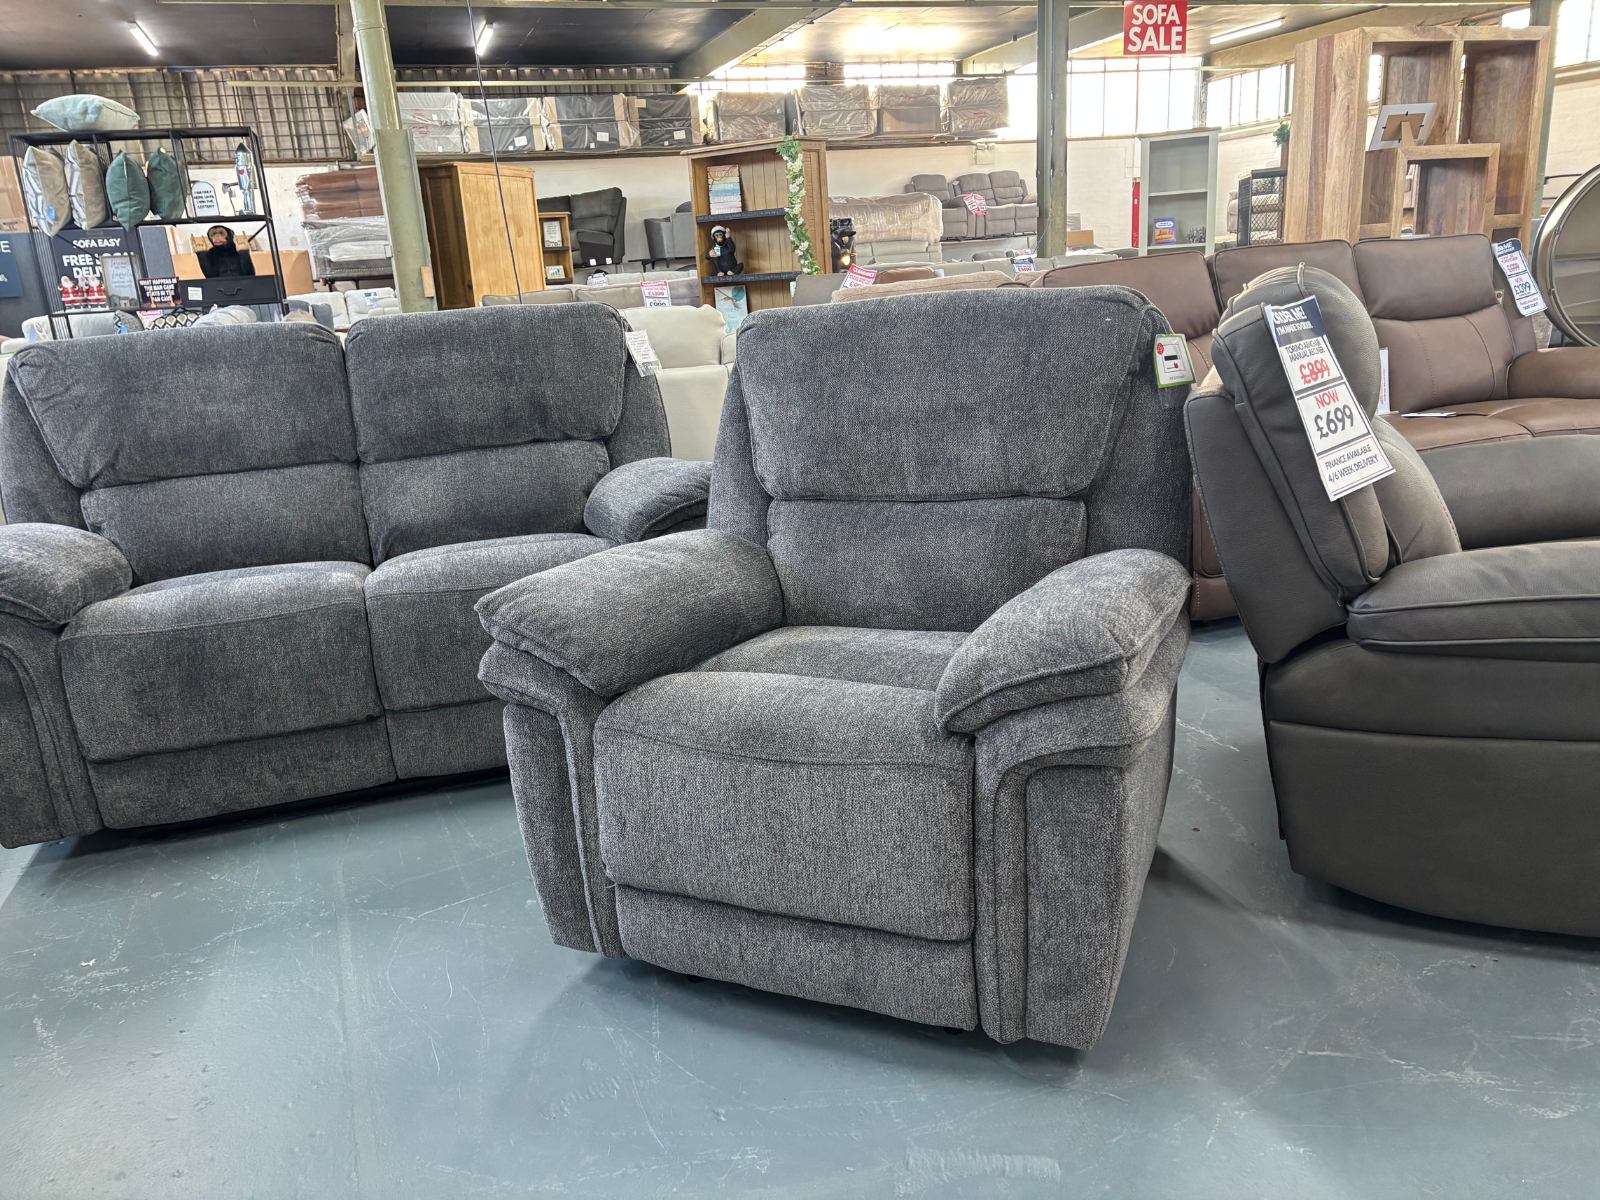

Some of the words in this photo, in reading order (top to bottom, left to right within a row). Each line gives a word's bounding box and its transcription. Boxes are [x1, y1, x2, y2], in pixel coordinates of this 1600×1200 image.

[1131, 4, 1181, 25] SOFA
[1127, 26, 1183, 52] SALE
[72, 239, 98, 249] SOFA
[97, 238, 121, 248] EASY
[62, 253, 94, 267] FREE
[853, 267, 875, 278] CLEARANCE
[1272, 309, 1296, 324] ORDER
[1291, 306, 1307, 321] ME!
[1285, 343, 1304, 354] TORINO
[1289, 350, 1310, 362] MANUAL
[1299, 358, 1331, 385] £899
[1314, 388, 1340, 409] NOW
[1314, 404, 1354, 440] £699
[1325, 453, 1348, 470] FINANCE
[1347, 444, 1373, 461] AVAILABLE
[1328, 470, 1340, 482] 4/6
[1338, 465, 1355, 479] WEEK
[1354, 454, 1379, 471] DELIVERY
